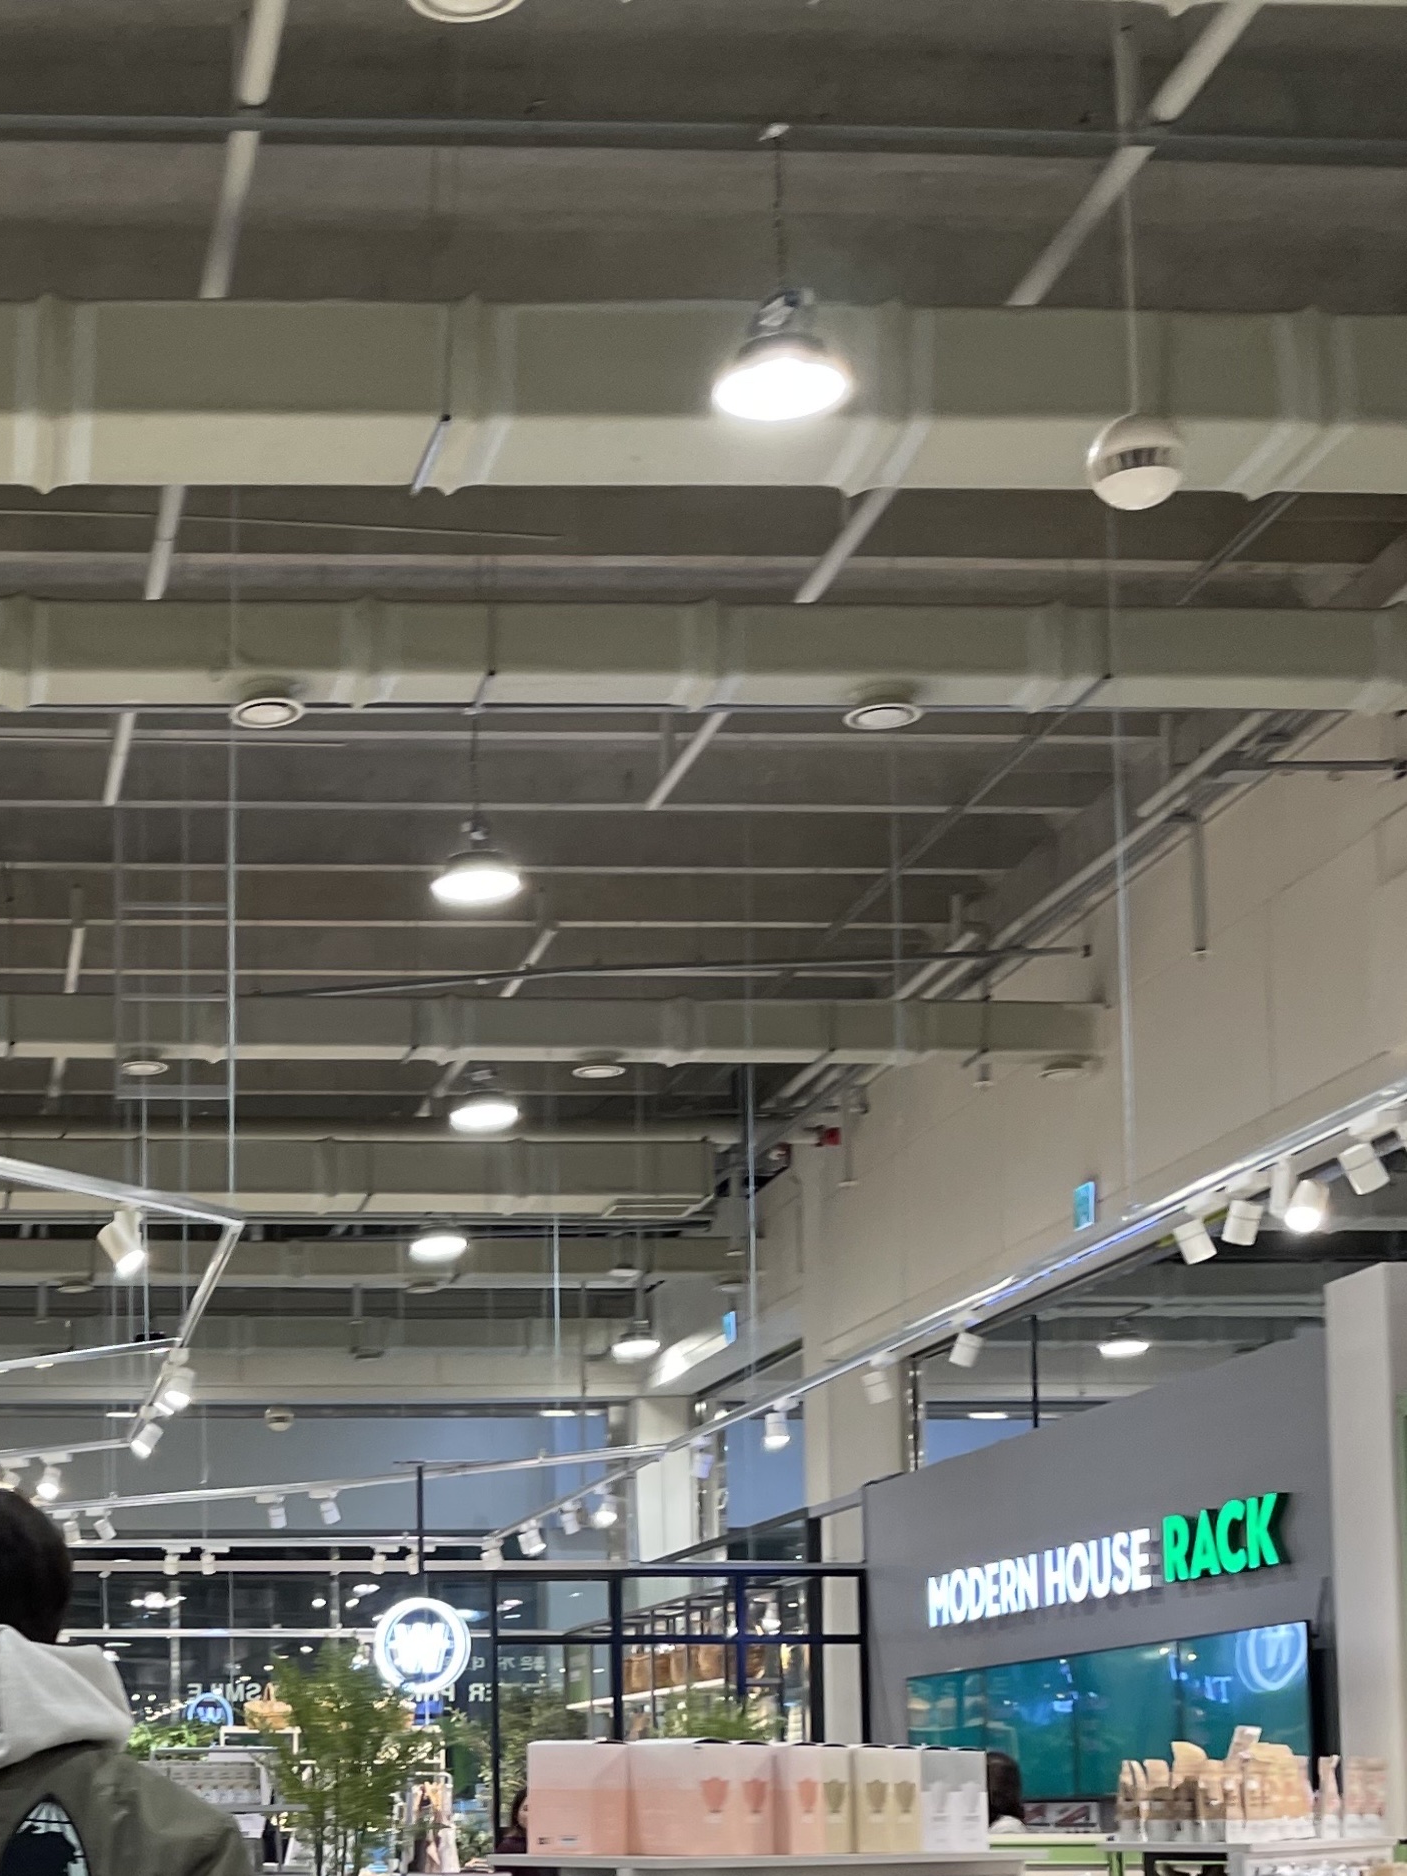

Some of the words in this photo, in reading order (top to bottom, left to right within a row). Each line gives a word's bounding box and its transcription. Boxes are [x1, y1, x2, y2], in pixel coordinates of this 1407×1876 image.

[927, 1553, 1042, 1629] MODERN
[1043, 1528, 1152, 1606] HOUSE
[1161, 1492, 1280, 1584] RACK
